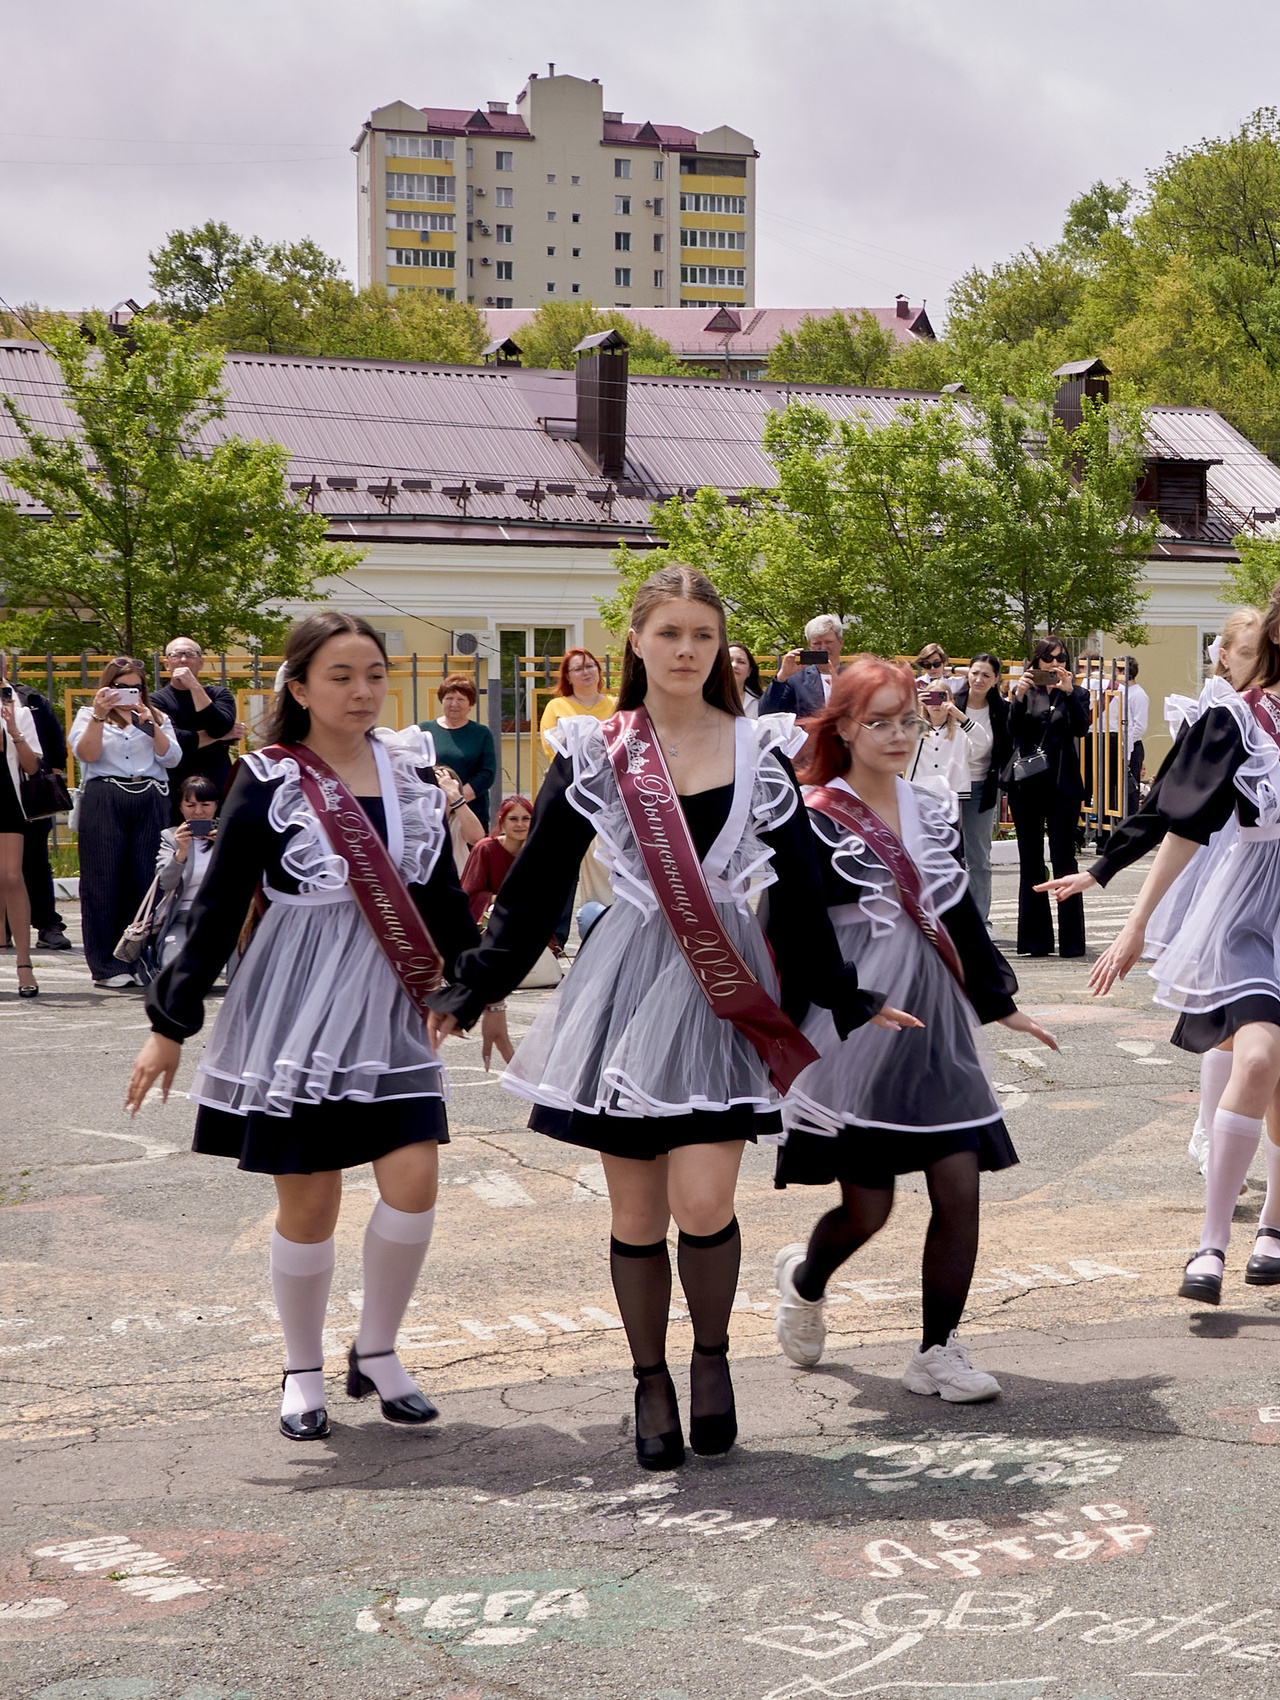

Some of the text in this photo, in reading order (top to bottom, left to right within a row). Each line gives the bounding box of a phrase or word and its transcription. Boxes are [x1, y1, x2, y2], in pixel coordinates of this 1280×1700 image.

[335, 811, 413, 953] Выпускница
[632, 774, 756, 997] Выпускница 2026
